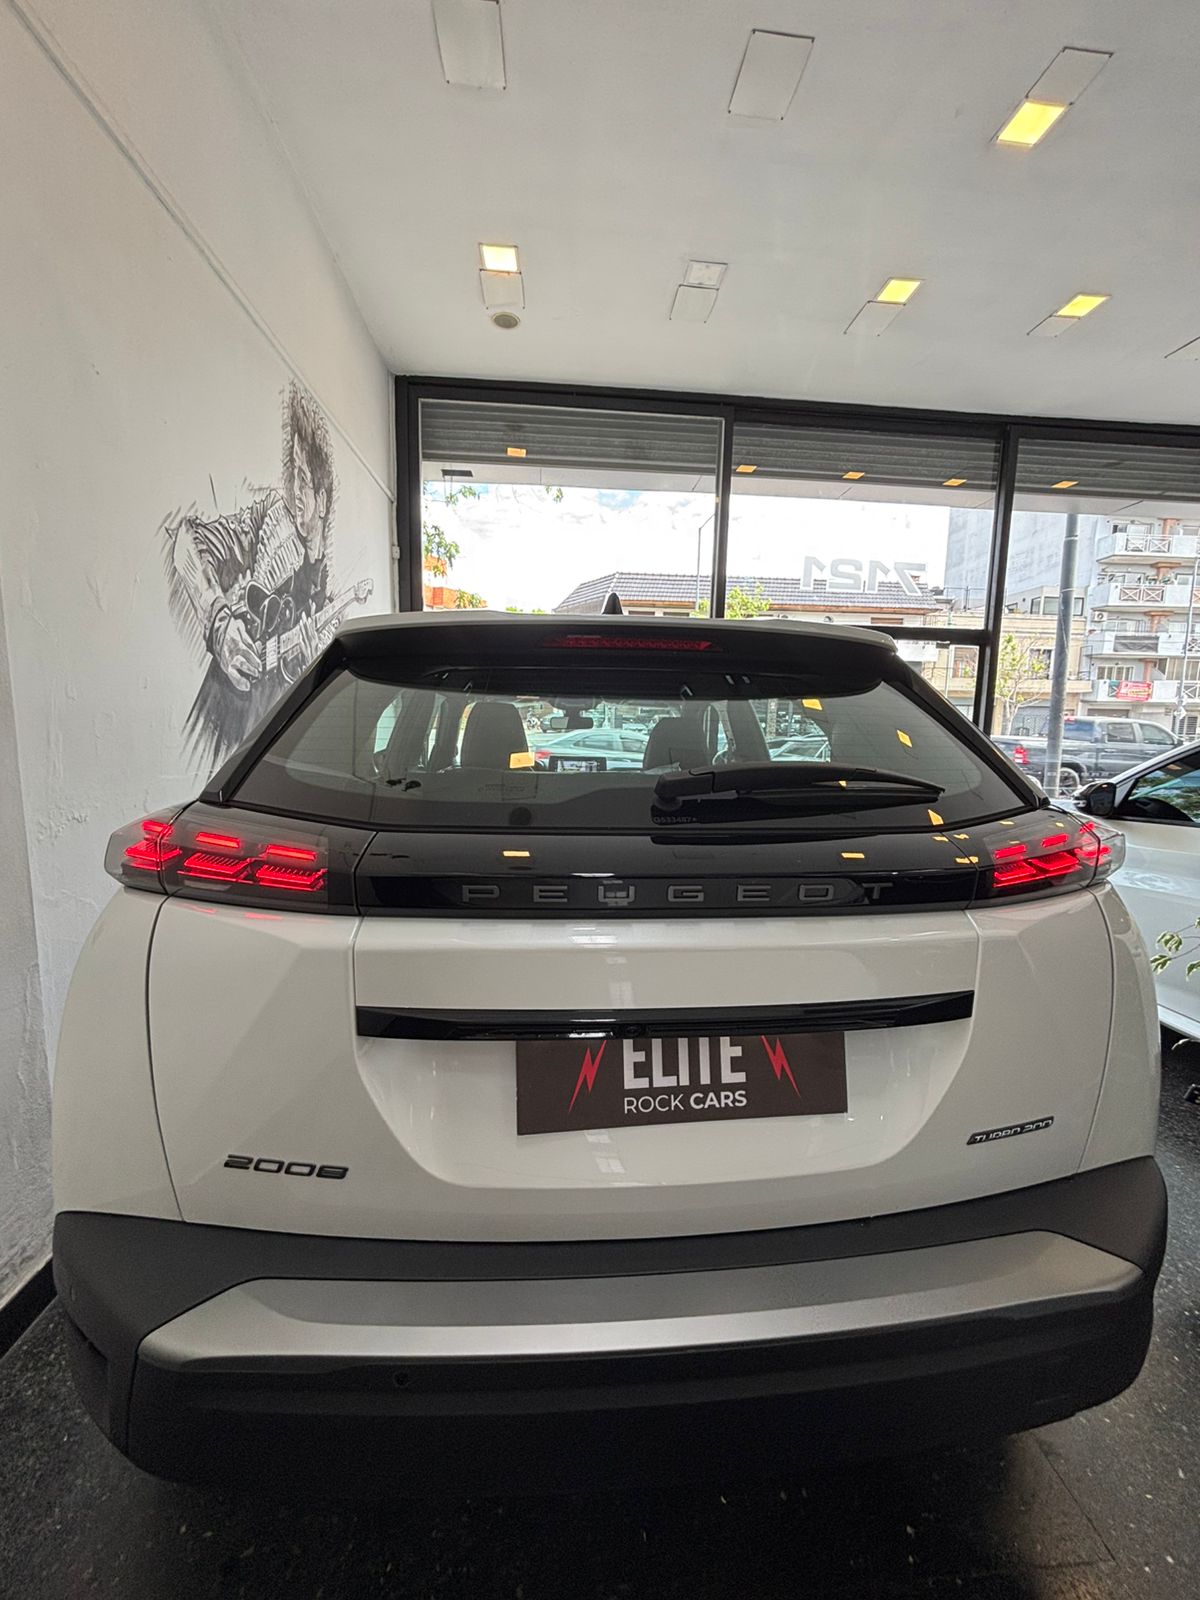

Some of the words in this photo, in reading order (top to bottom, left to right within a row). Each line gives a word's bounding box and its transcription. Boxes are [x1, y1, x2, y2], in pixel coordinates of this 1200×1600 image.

[461, 882, 893, 903] PEUGEOT
[624, 1093, 685, 1114] ROCK
[689, 1090, 748, 1110] CARS
[223, 1153, 349, 1180] 2008
